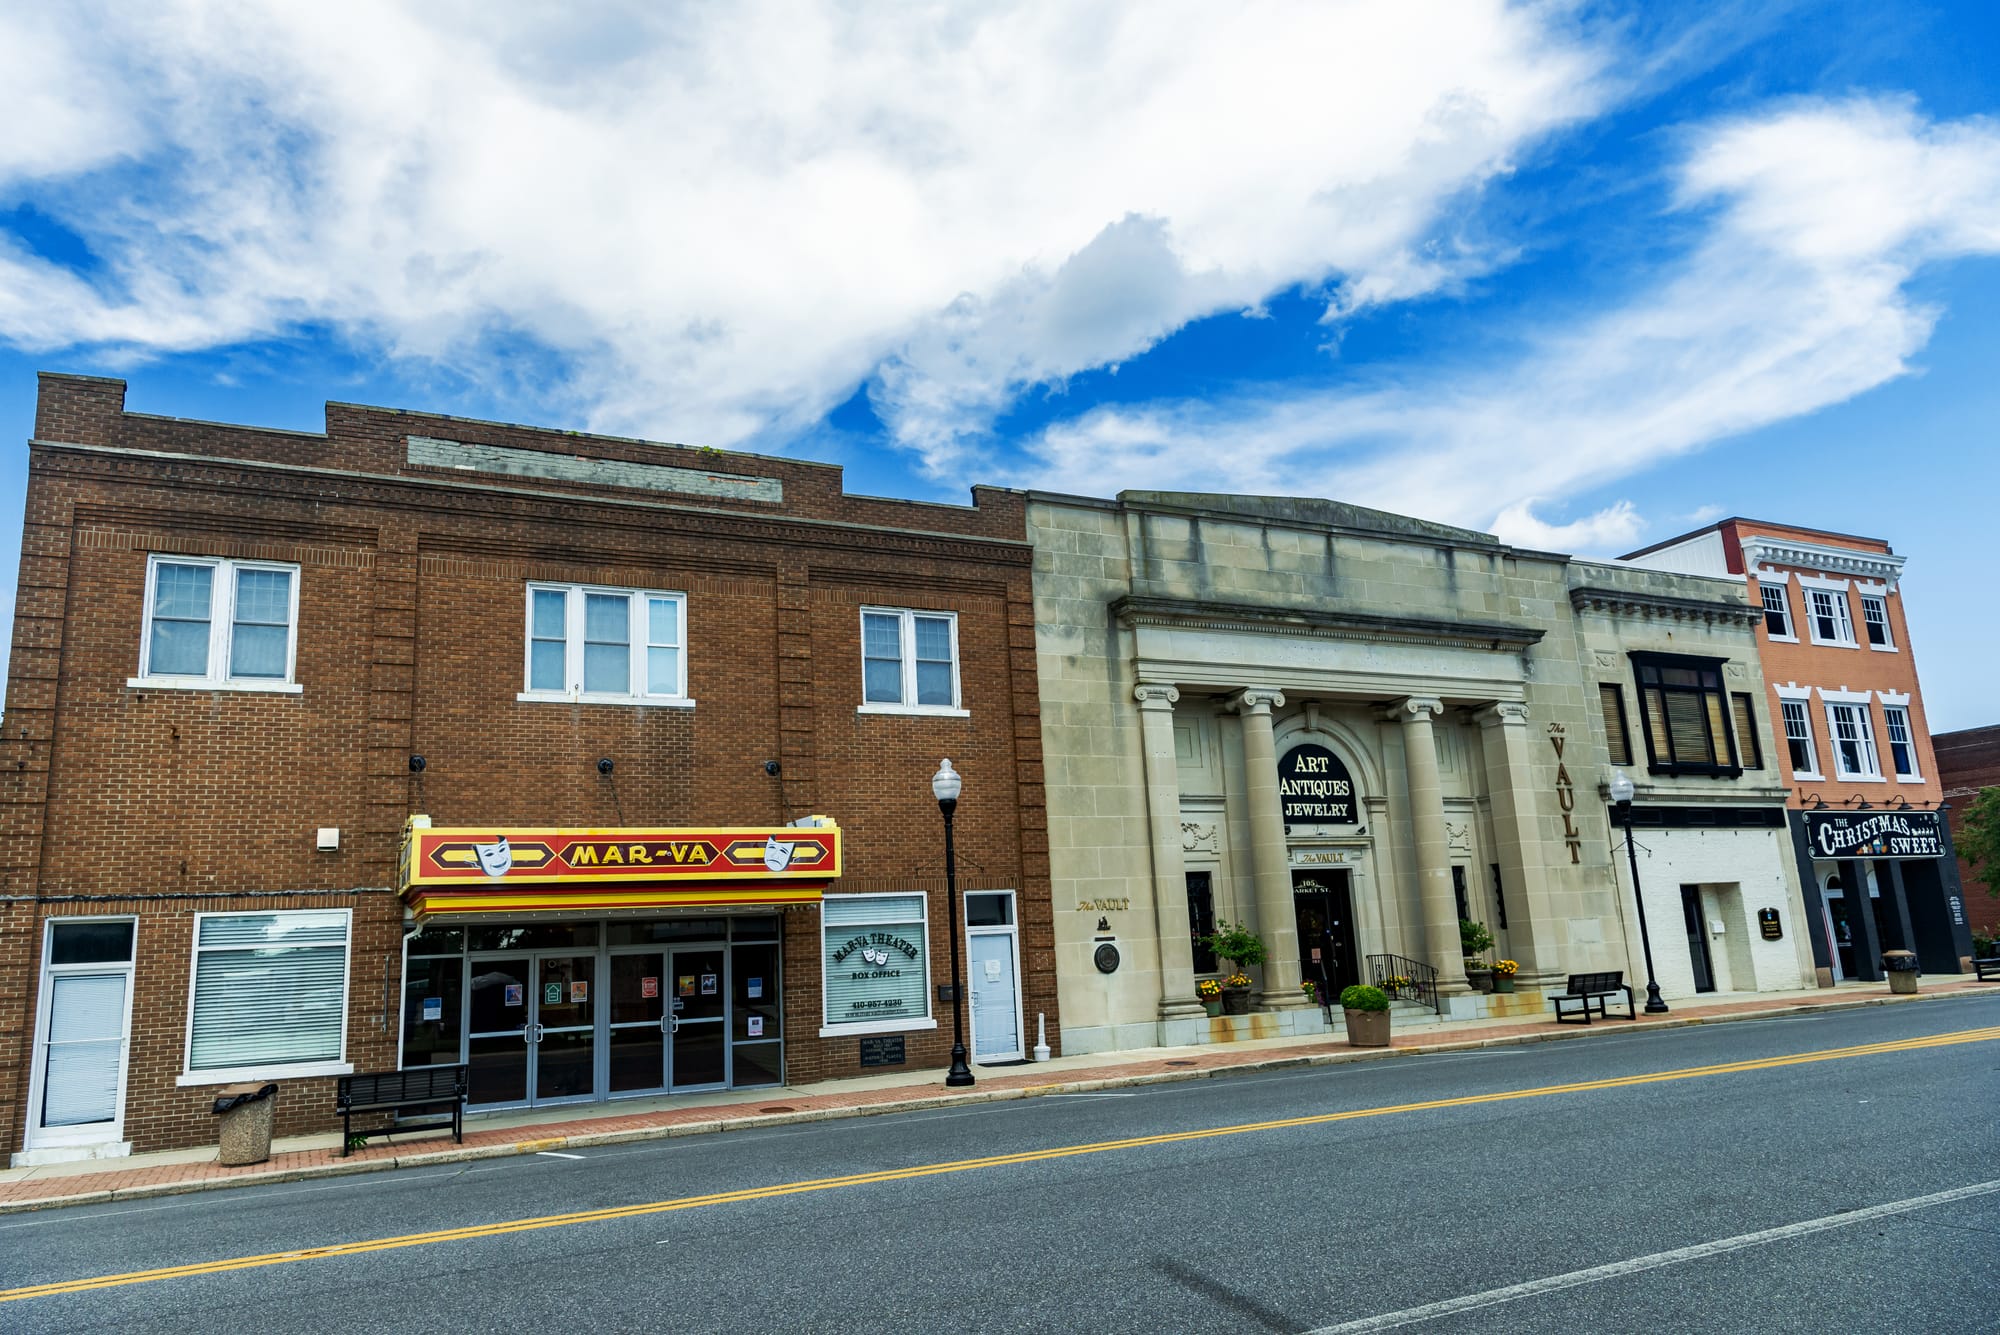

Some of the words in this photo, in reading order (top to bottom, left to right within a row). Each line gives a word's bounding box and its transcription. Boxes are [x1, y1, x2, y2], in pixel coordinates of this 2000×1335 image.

[1547, 723, 1565, 733] The
[1295, 754, 1329, 772] ART
[1280, 776, 1350, 799] ANTIQUES
[1550, 737, 1581, 864] VAULT
[1285, 803, 1348, 816] JEWELRY
[1834, 818, 1849, 828] THE
[1818, 815, 1910, 855] CHRISTMAS
[1890, 837, 1937, 854] SWEET
[570, 845, 709, 865] MAR-VA
[1316, 851, 1344, 863] VAULT
[1076, 901, 1095, 911] The
[1094, 897, 1130, 911] VAULT
[869, 932, 919, 960] THEATER
[852, 971, 870, 980] BOX
[871, 970, 901, 978] OFFICE
